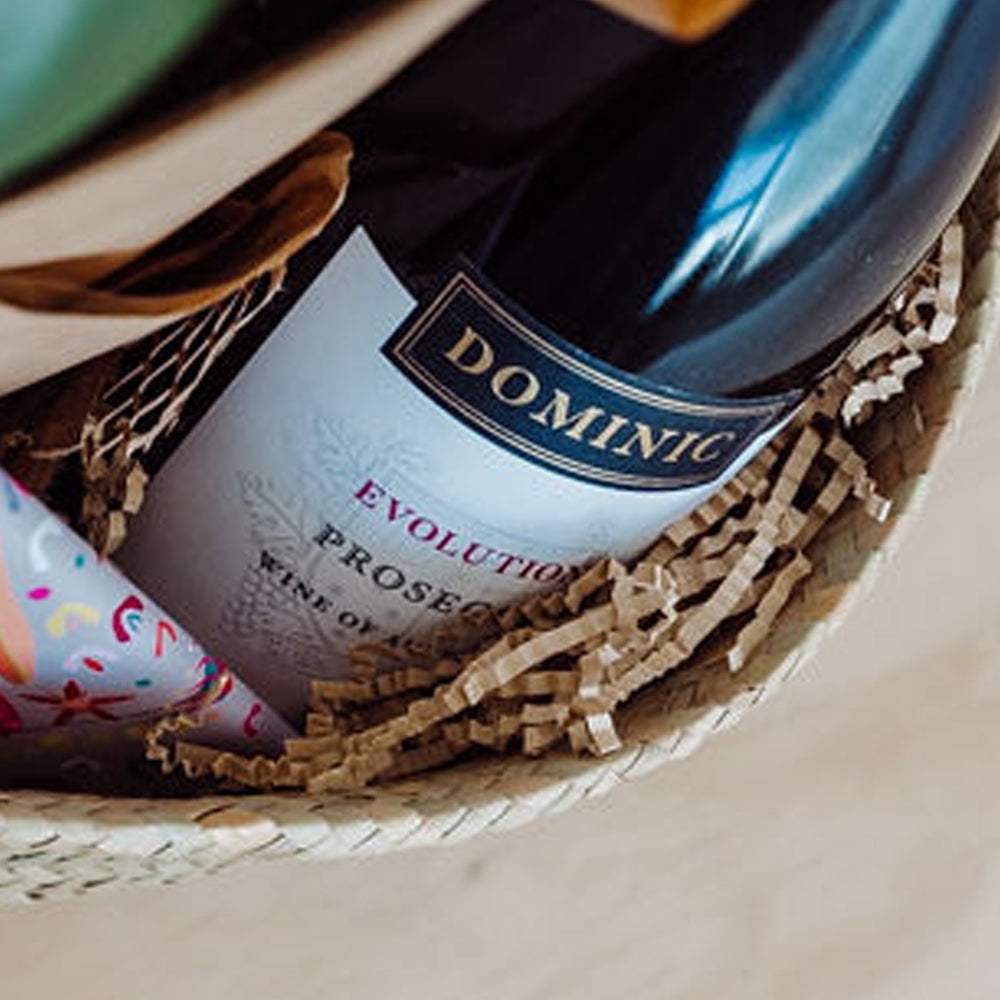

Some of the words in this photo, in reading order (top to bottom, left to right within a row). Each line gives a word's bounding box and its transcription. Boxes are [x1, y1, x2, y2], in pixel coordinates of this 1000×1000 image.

[444, 325, 737, 464] DOMINIC
[260, 549, 334, 613] WINE
[338, 611, 379, 635] OF
